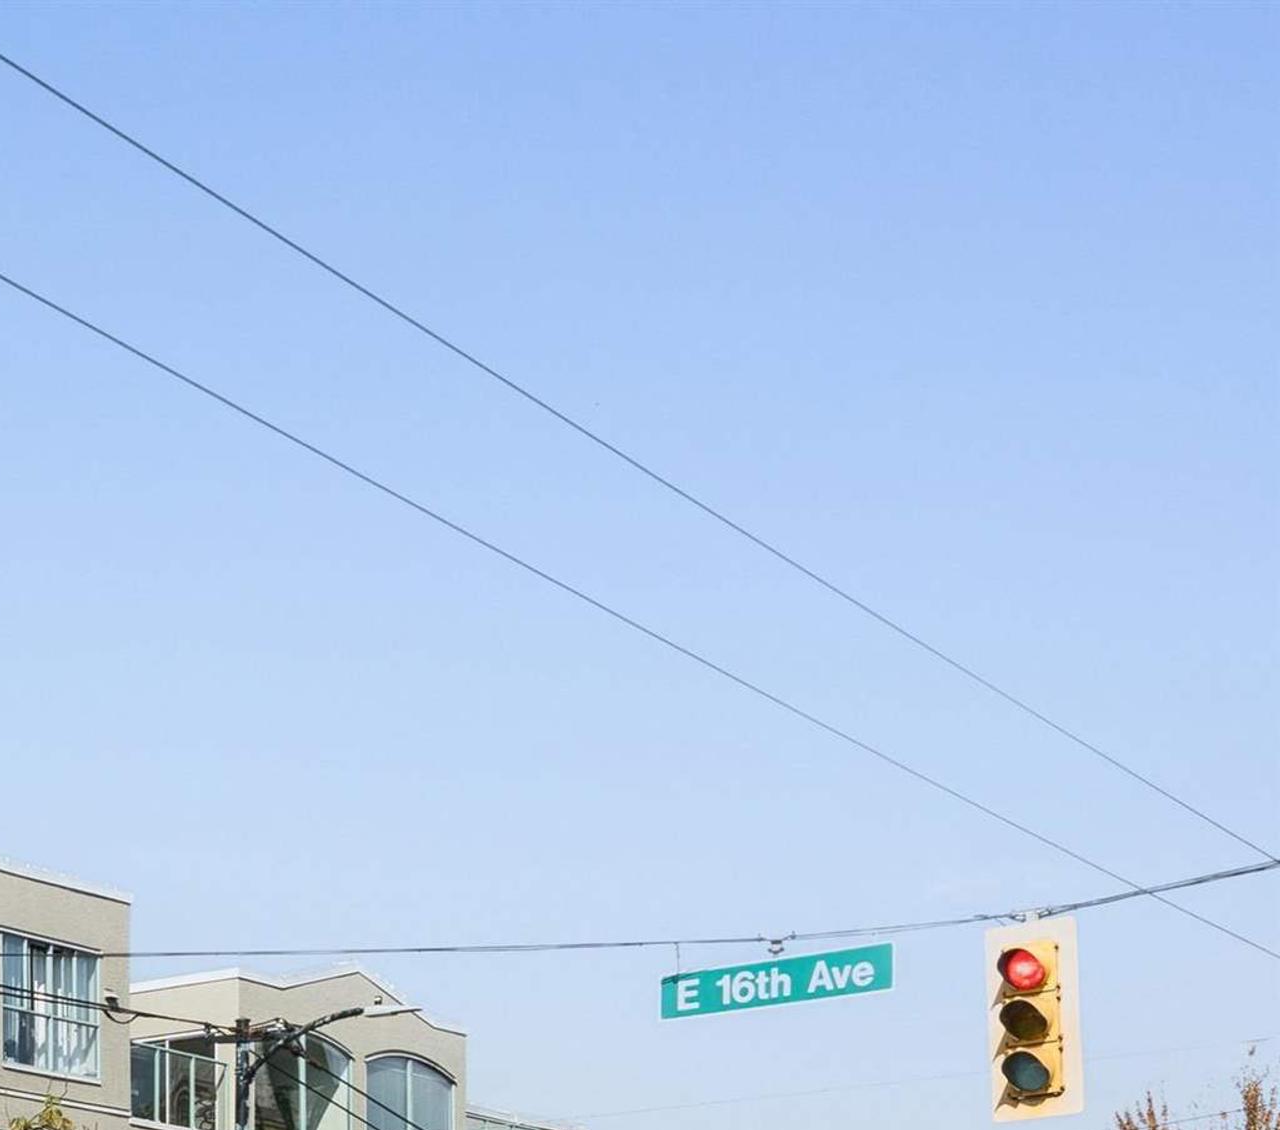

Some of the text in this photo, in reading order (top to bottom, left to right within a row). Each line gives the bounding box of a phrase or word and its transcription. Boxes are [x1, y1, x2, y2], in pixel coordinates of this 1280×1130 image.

[676, 960, 875, 1011] E 16th Ave
